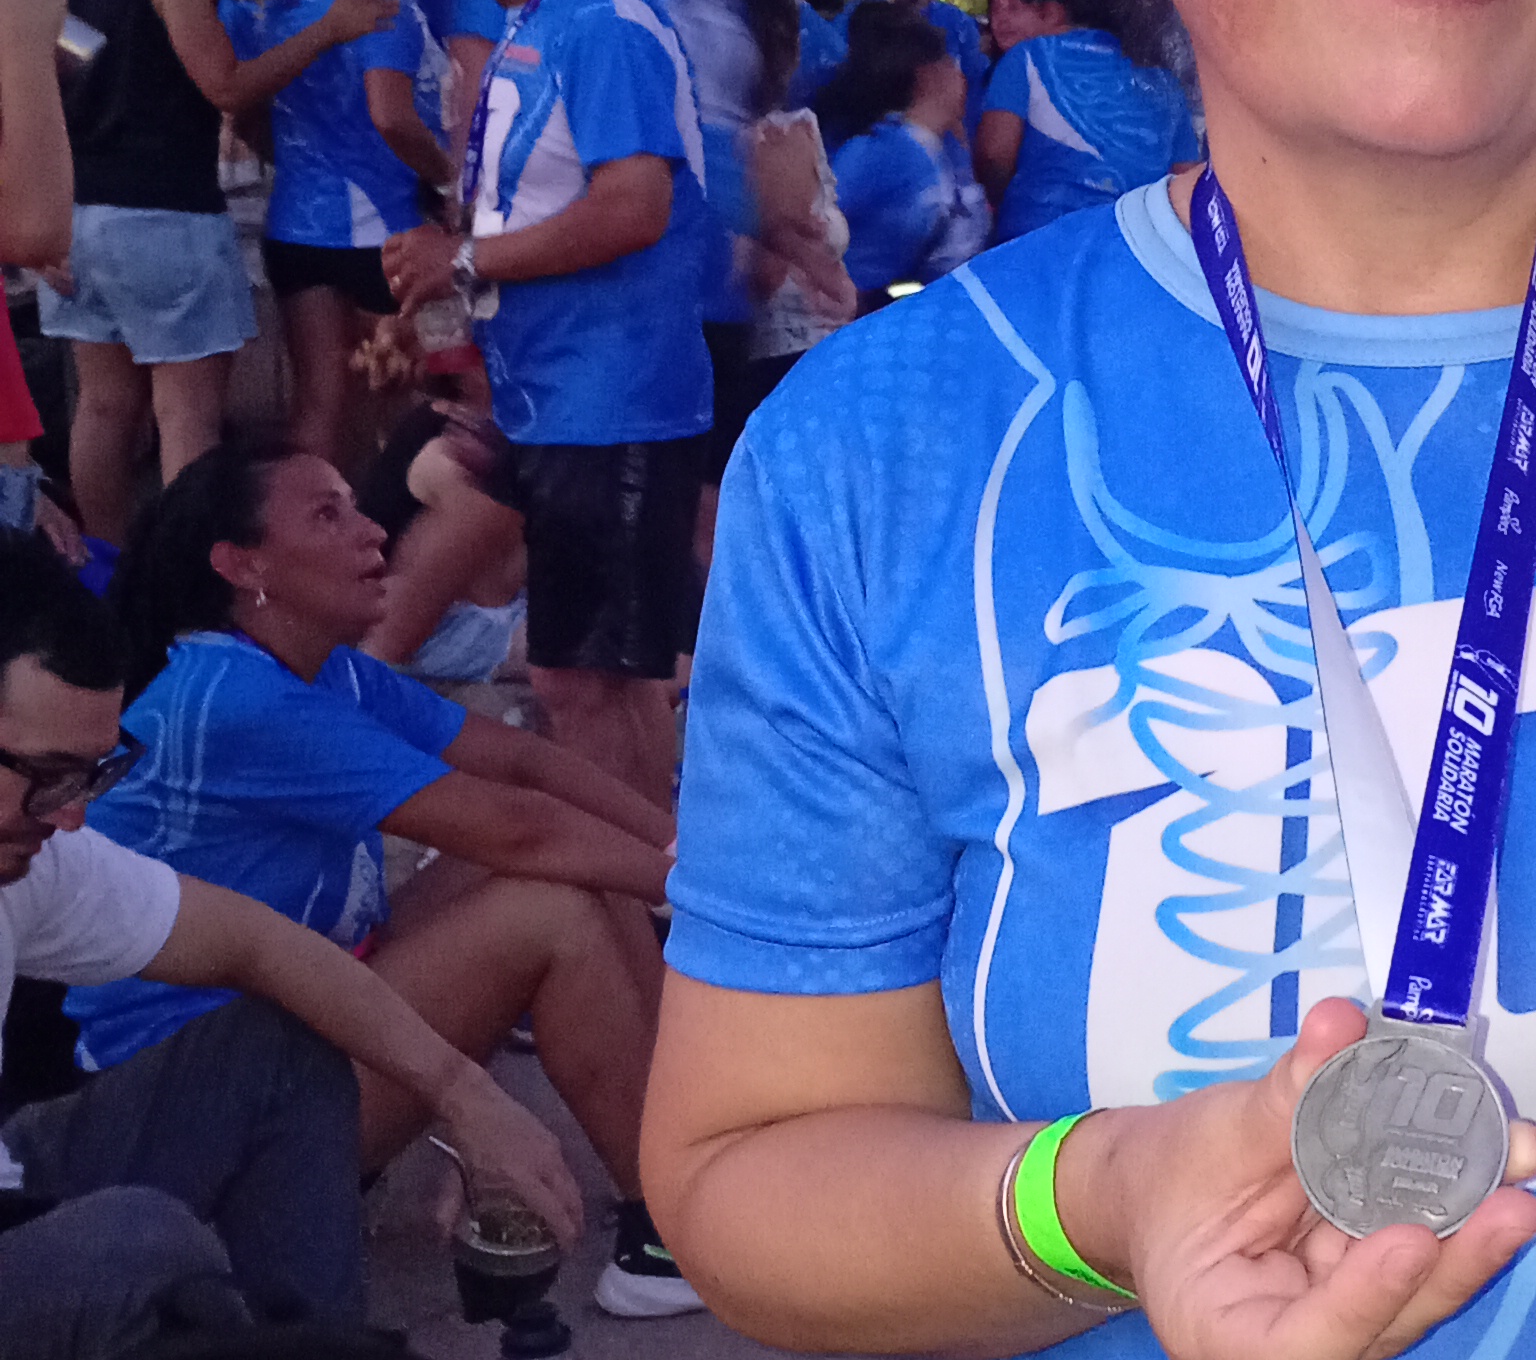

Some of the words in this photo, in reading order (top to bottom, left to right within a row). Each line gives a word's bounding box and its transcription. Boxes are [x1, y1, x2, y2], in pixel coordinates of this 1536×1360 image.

[1453, 673, 1499, 737] 10
[1432, 726, 1467, 823] SOLIDARIA
[1383, 1065, 1486, 1137] 10
